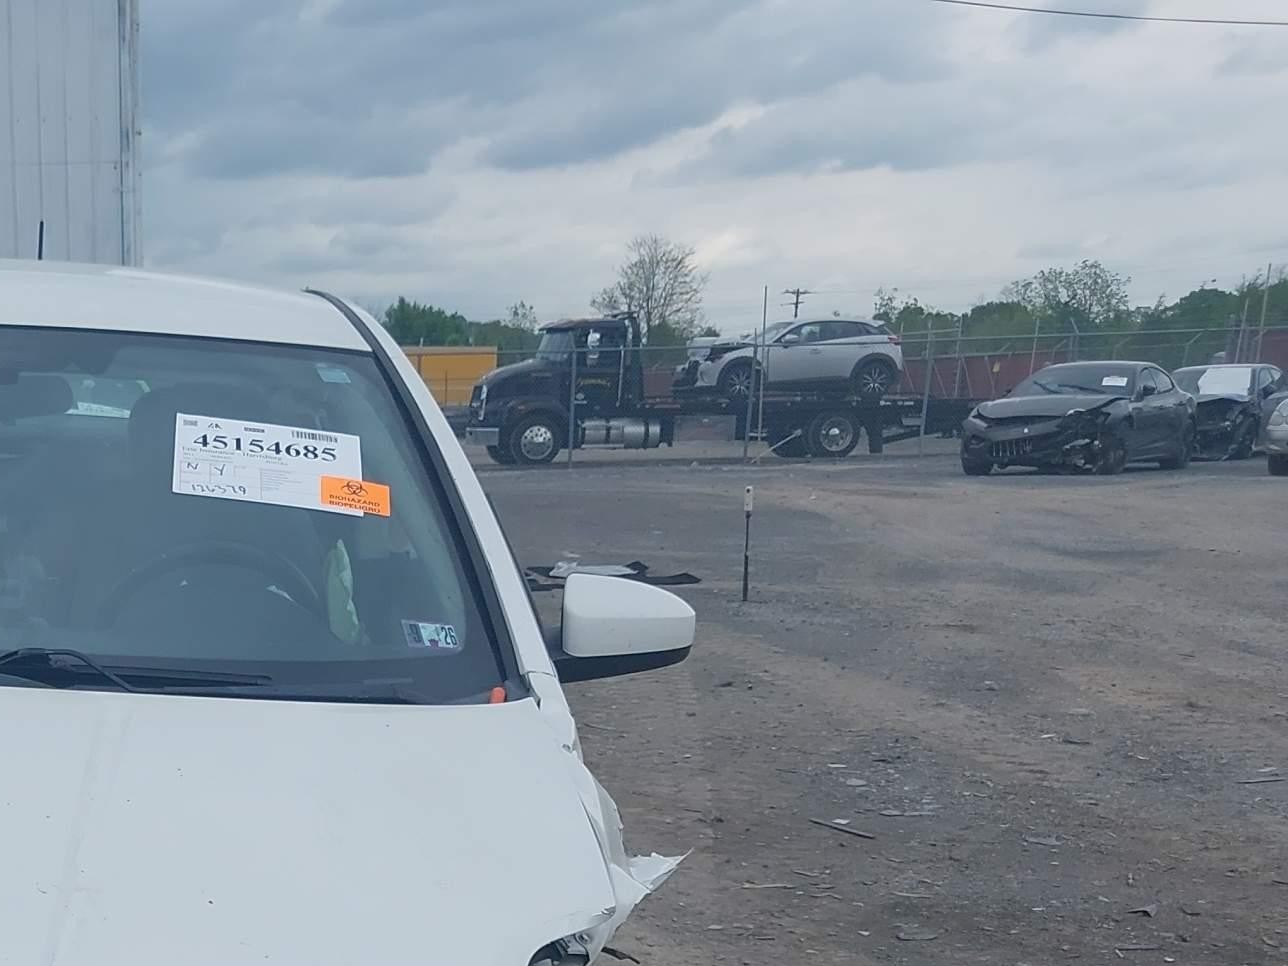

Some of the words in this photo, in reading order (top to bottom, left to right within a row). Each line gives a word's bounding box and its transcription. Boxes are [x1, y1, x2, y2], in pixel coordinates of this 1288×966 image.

[193, 433, 338, 462] 45154685
[186, 462, 199, 470] N
[214, 463, 226, 476] Y
[329, 494, 381, 507] BIOHAZARD
